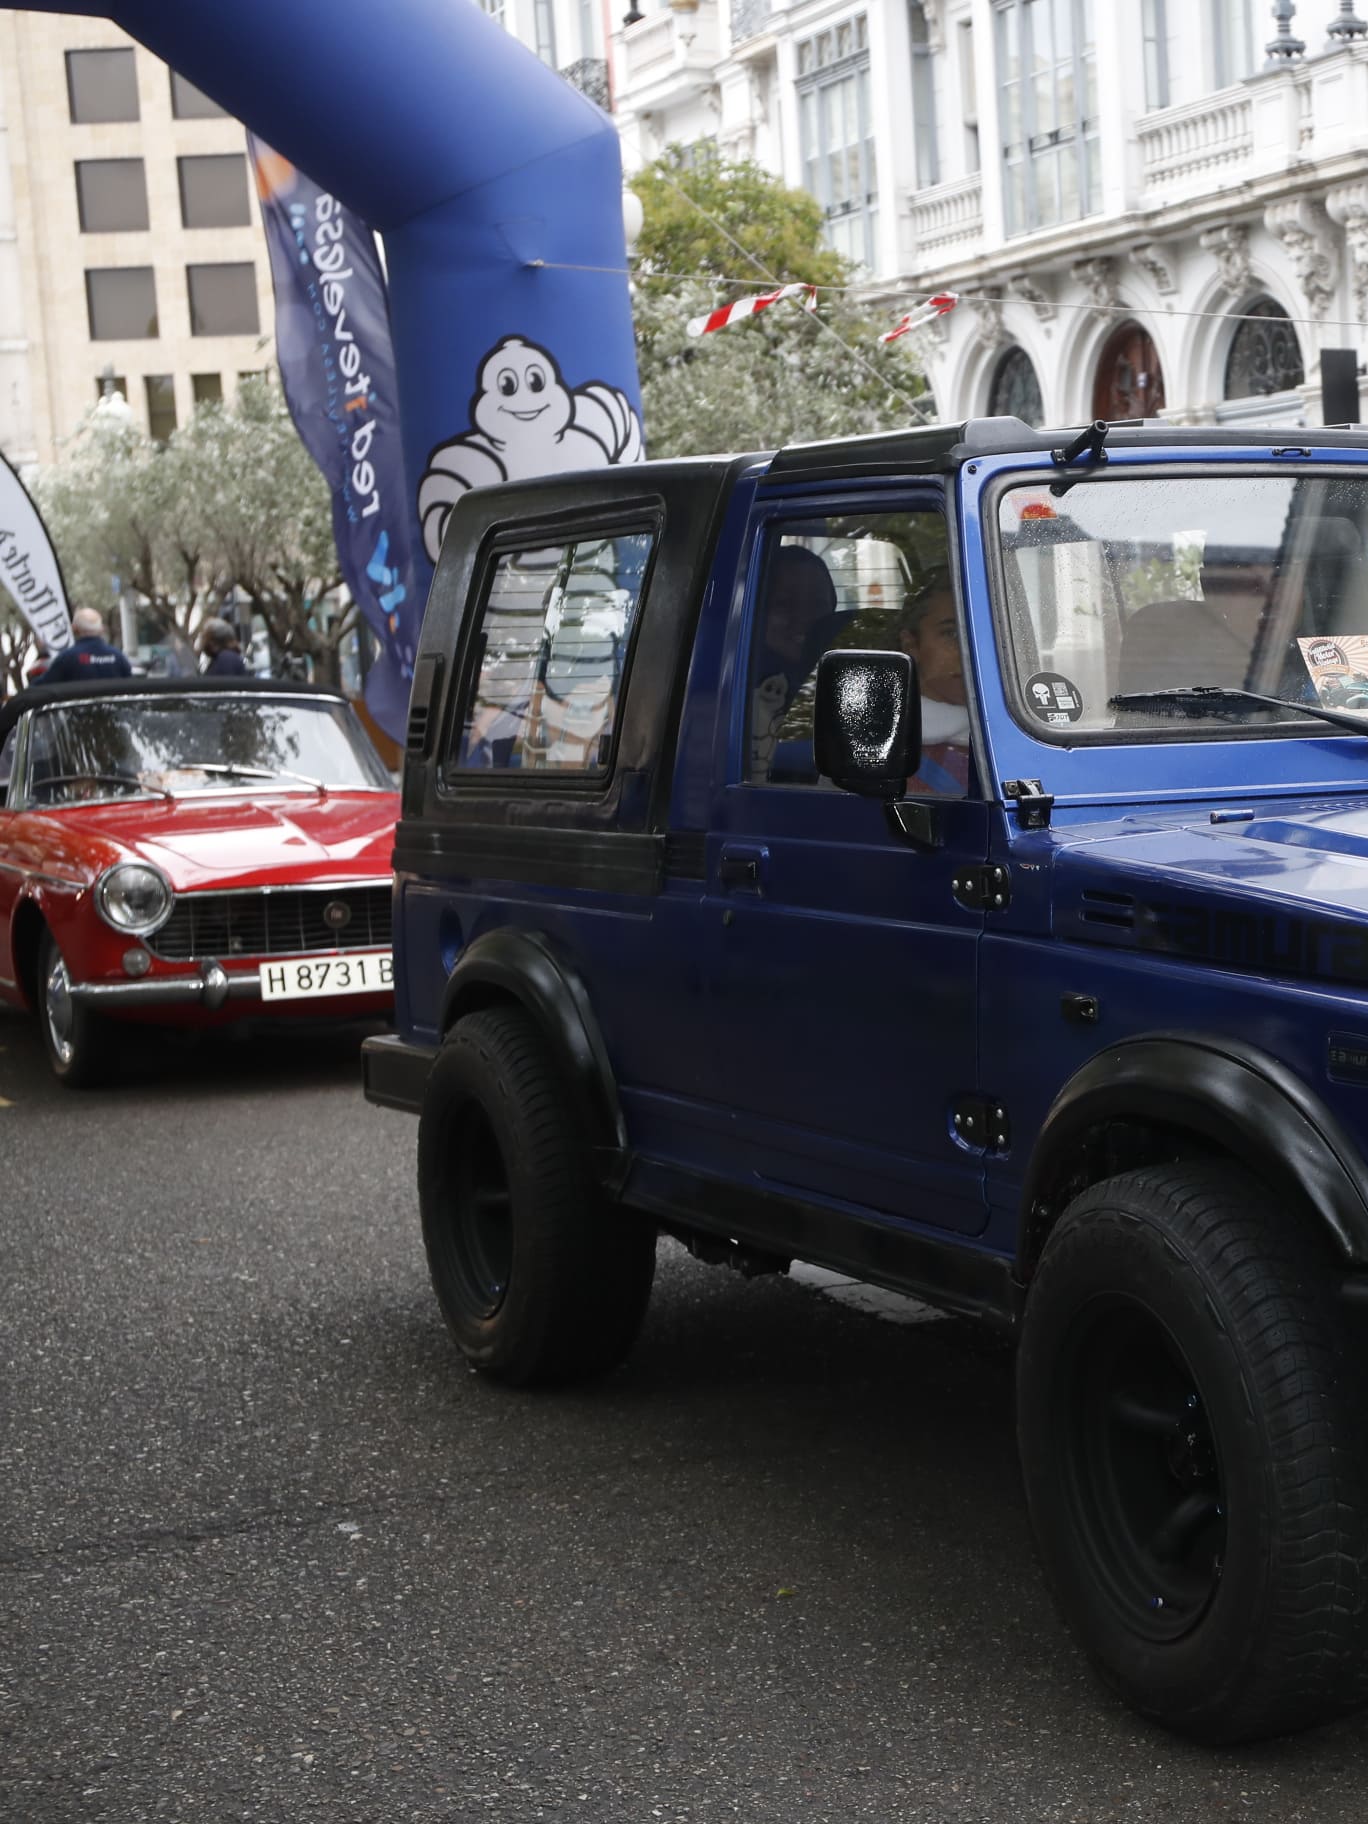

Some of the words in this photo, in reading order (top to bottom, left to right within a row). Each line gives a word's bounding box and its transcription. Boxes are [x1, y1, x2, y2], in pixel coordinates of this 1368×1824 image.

[267, 966, 286, 994] H
[296, 960, 366, 991] 8731
[379, 958, 393, 984] B
